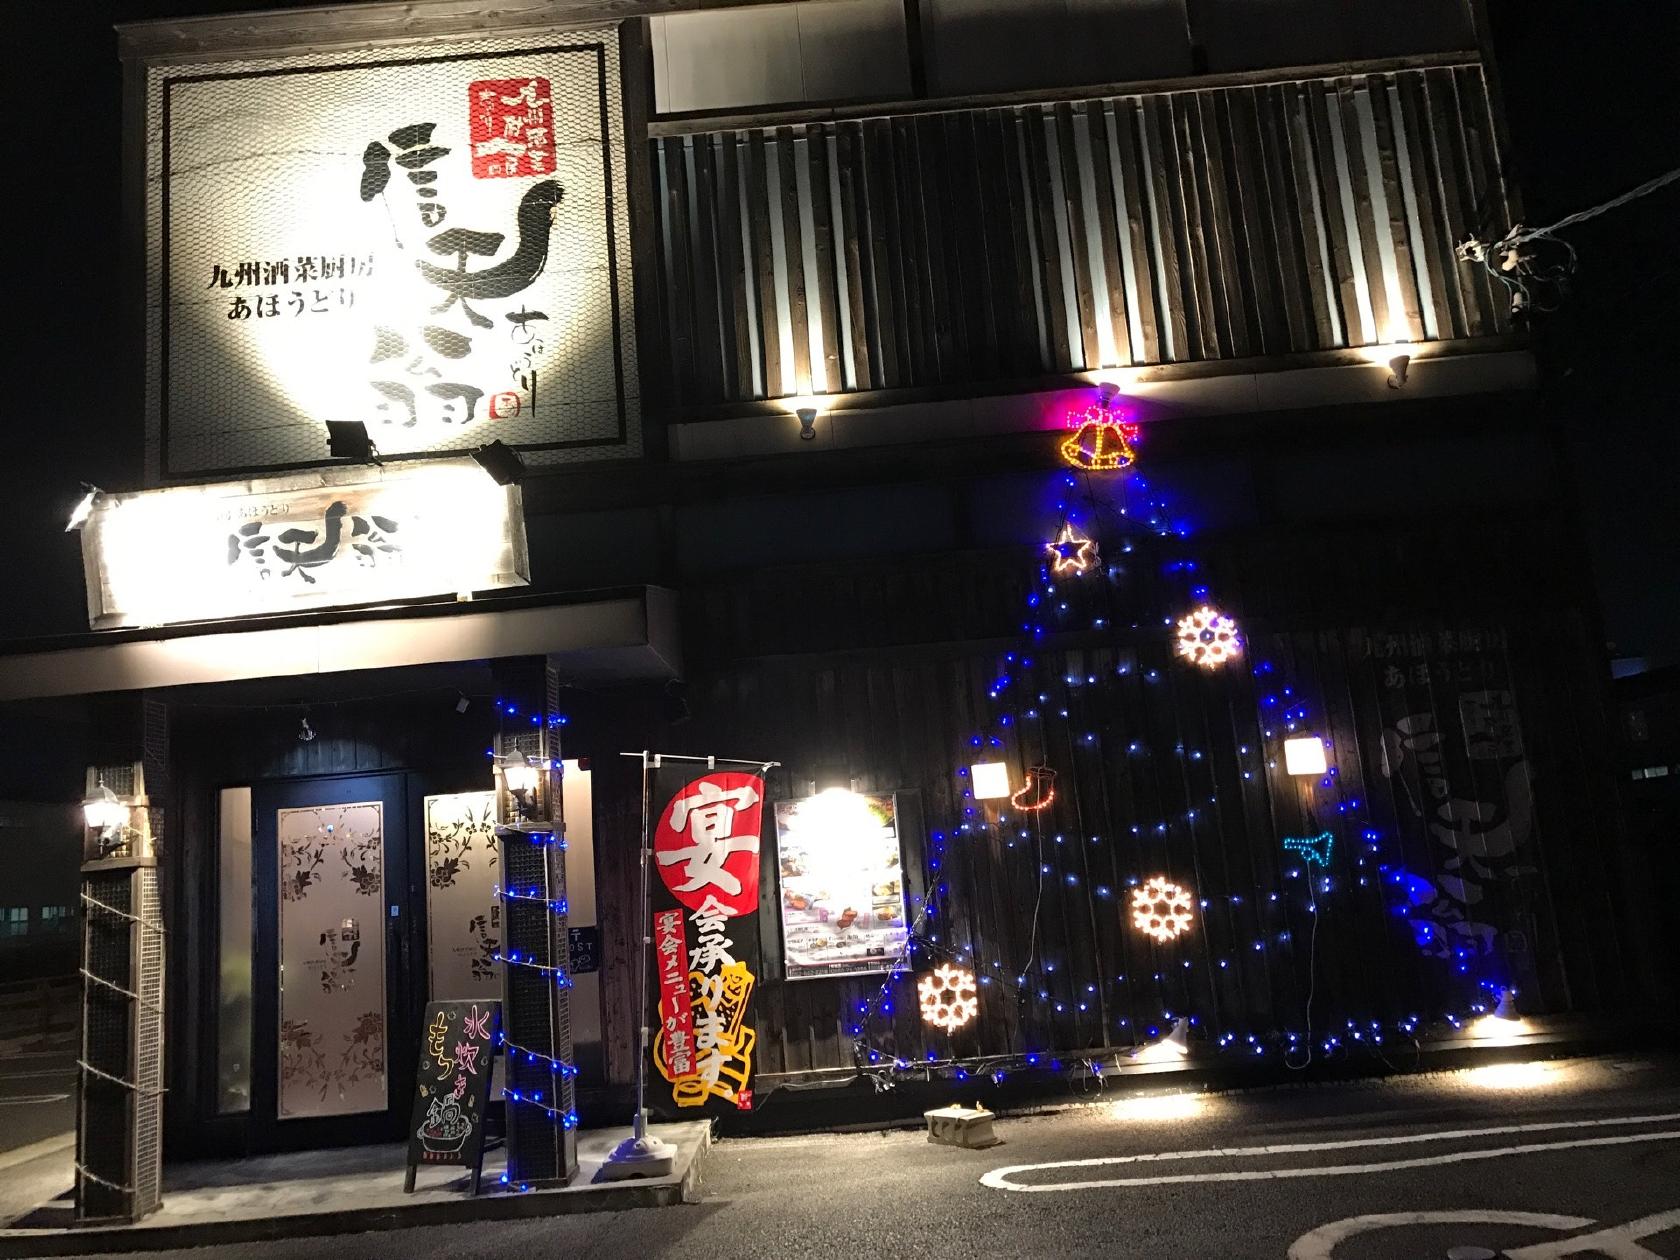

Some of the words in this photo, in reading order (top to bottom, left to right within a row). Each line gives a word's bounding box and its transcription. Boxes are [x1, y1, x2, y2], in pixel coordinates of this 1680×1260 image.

[228, 286, 355, 320] あほうどり
[569, 942, 593, 952] OST
[656, 911, 692, 1076] 宴会メニューが豊富
[454, 1004, 490, 1100] 水炊き
